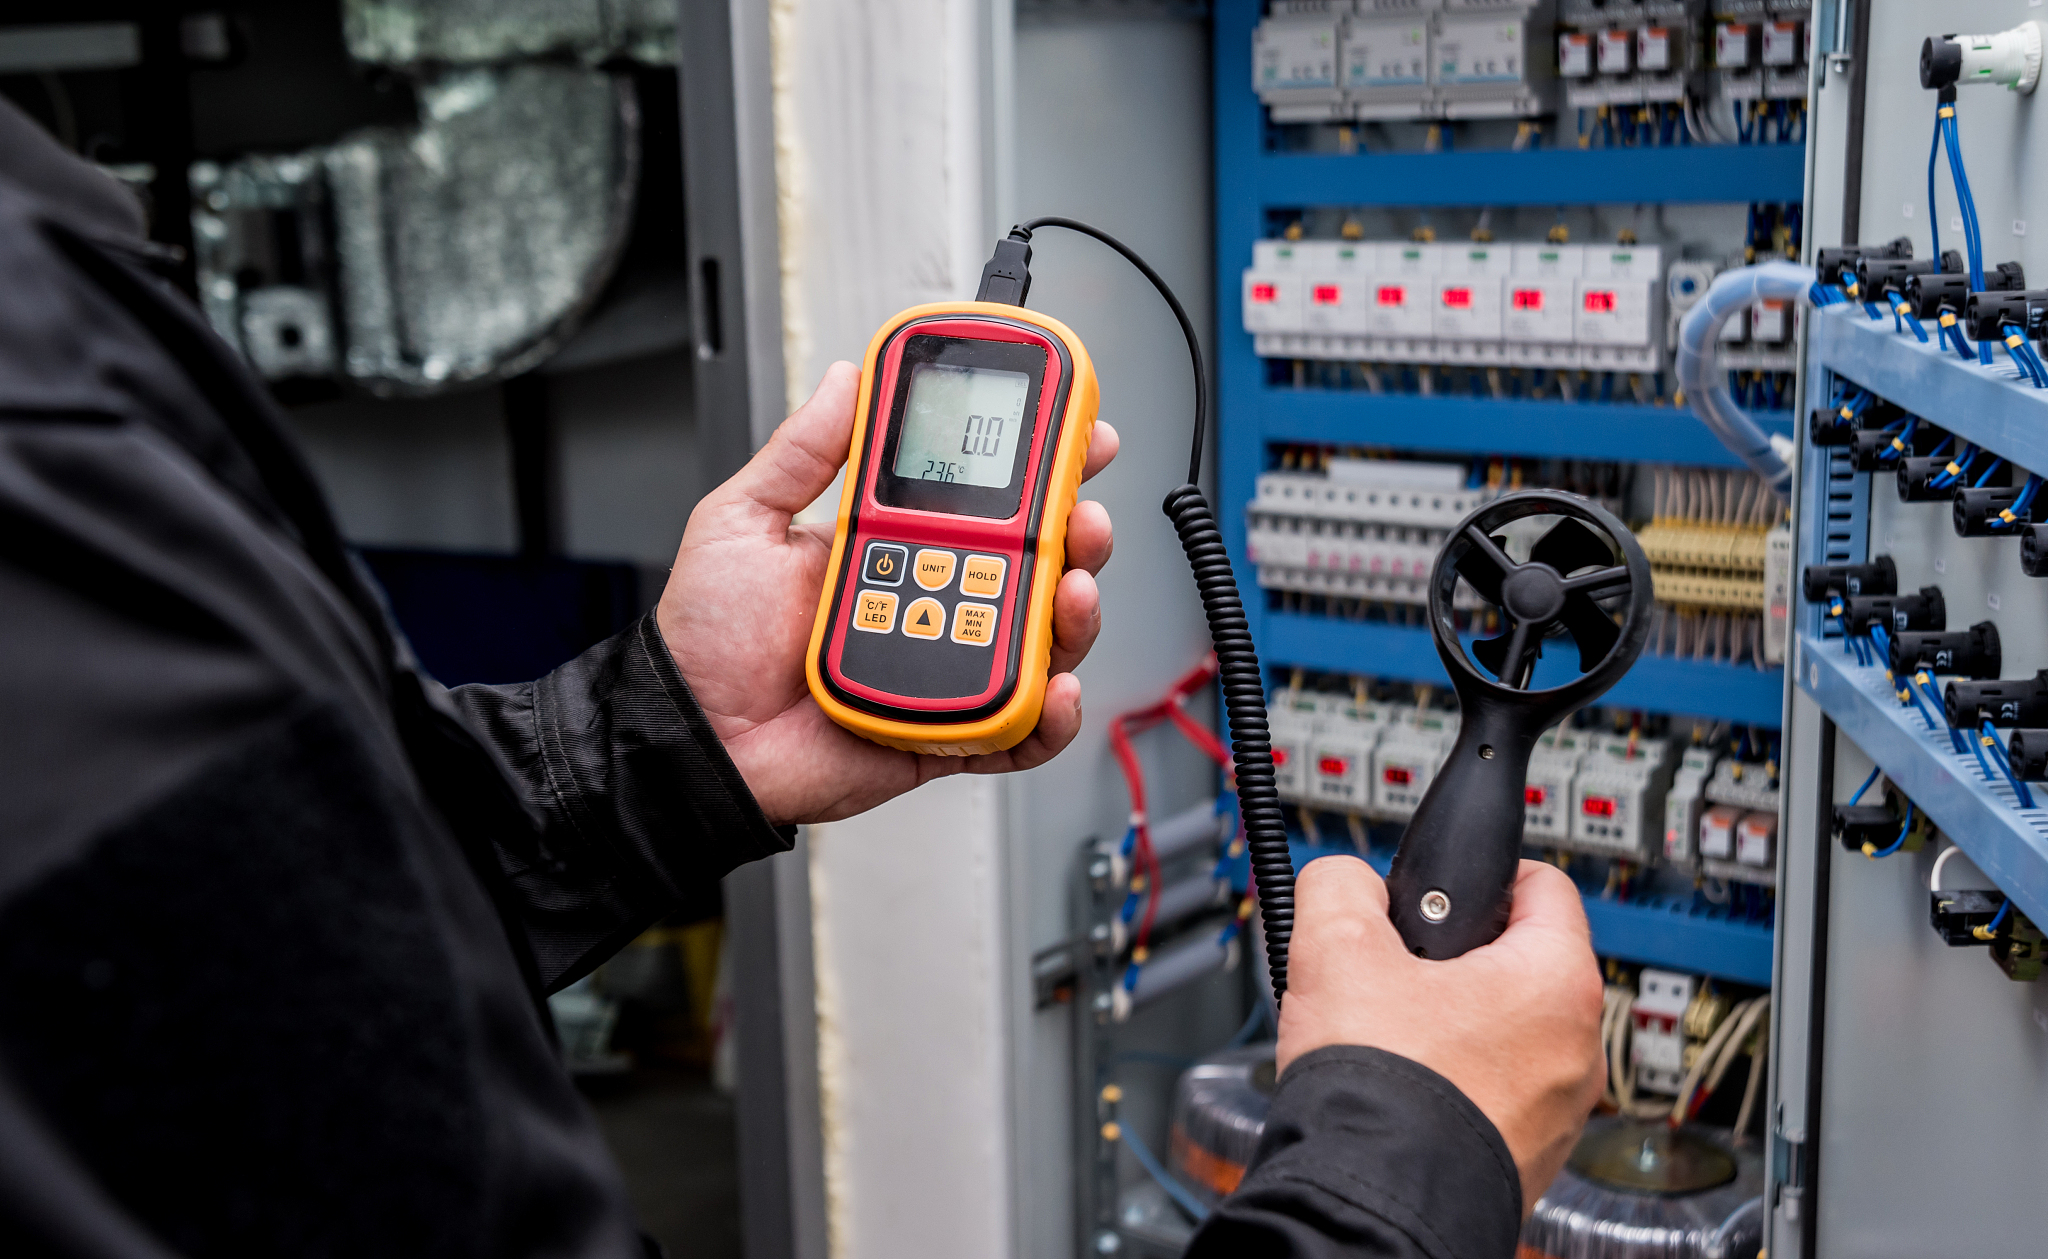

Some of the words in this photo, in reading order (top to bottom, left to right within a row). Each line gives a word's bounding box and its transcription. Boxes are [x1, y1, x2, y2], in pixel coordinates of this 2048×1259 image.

[961, 414, 1004, 458] 0.0
[922, 563, 947, 574] UNIT
[968, 570, 997, 582] HOLD
[864, 612, 887, 624] LED
[965, 609, 986, 619] MAX
[965, 619, 983, 628] MIN
[962, 628, 982, 638] AVG
